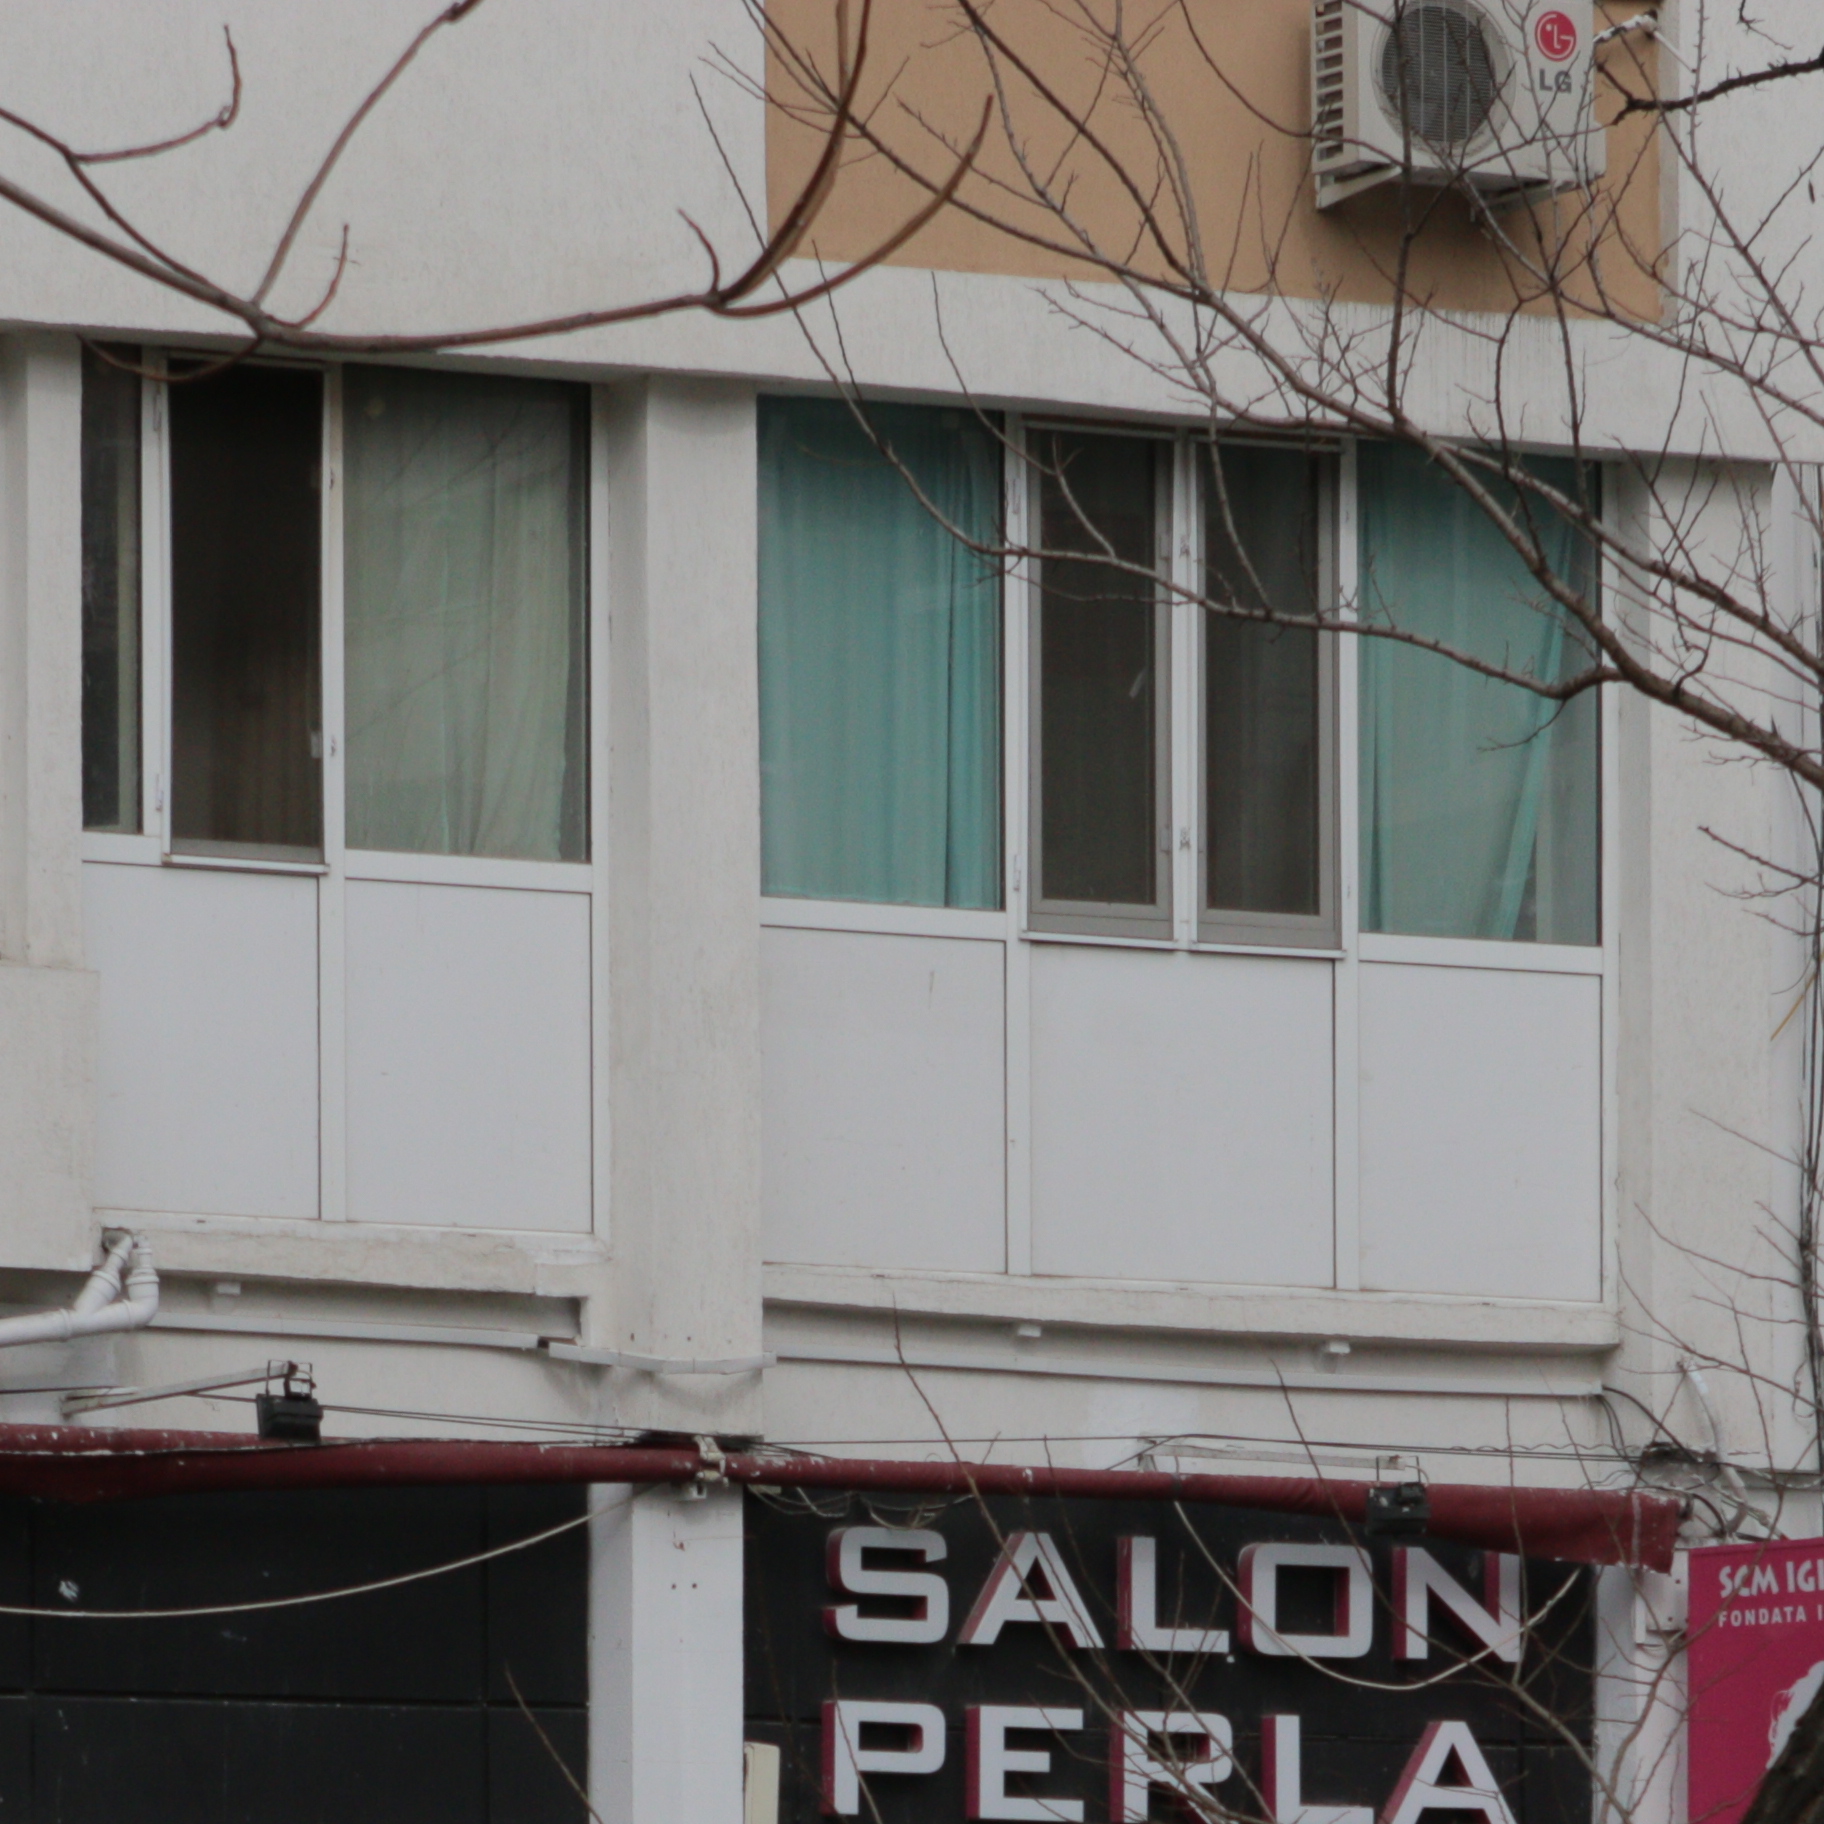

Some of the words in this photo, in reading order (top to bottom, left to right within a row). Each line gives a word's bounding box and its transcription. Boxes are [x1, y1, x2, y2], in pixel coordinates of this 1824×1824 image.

[1538, 69, 1573, 94] LG
[824, 1526, 1522, 1662] SALON
[1718, 1565, 1779, 1598] SCM
[1718, 1605, 1807, 1628] FONDATA
